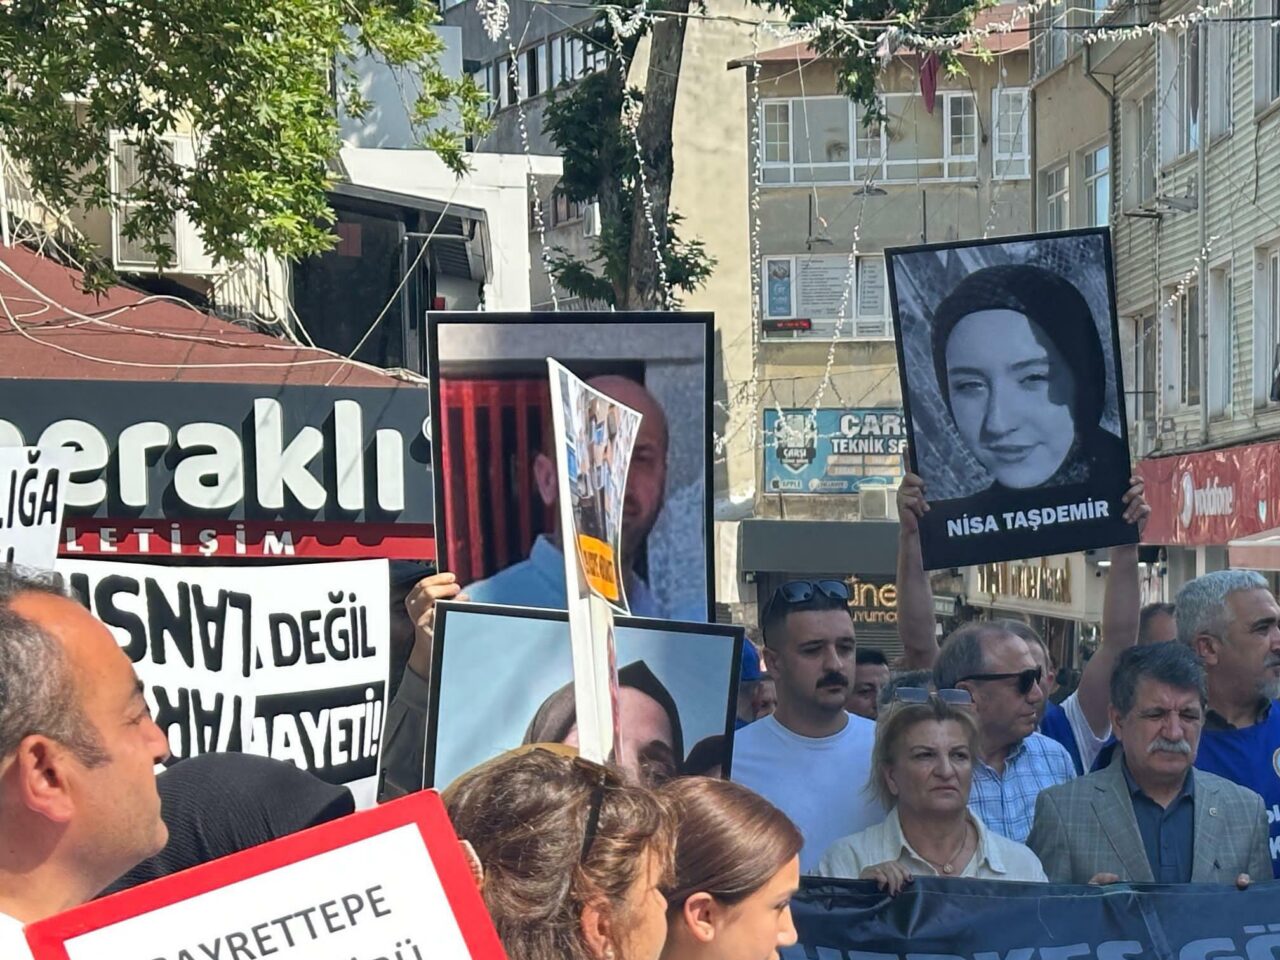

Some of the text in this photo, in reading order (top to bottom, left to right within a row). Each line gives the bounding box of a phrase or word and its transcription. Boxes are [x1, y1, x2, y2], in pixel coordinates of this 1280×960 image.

[832, 437, 884, 453] TEKNİK
[0, 449, 60, 528] IĞA
[946, 497, 1110, 537] NİSA TAŞDEMİR
[268, 590, 377, 667] DEĞİL
